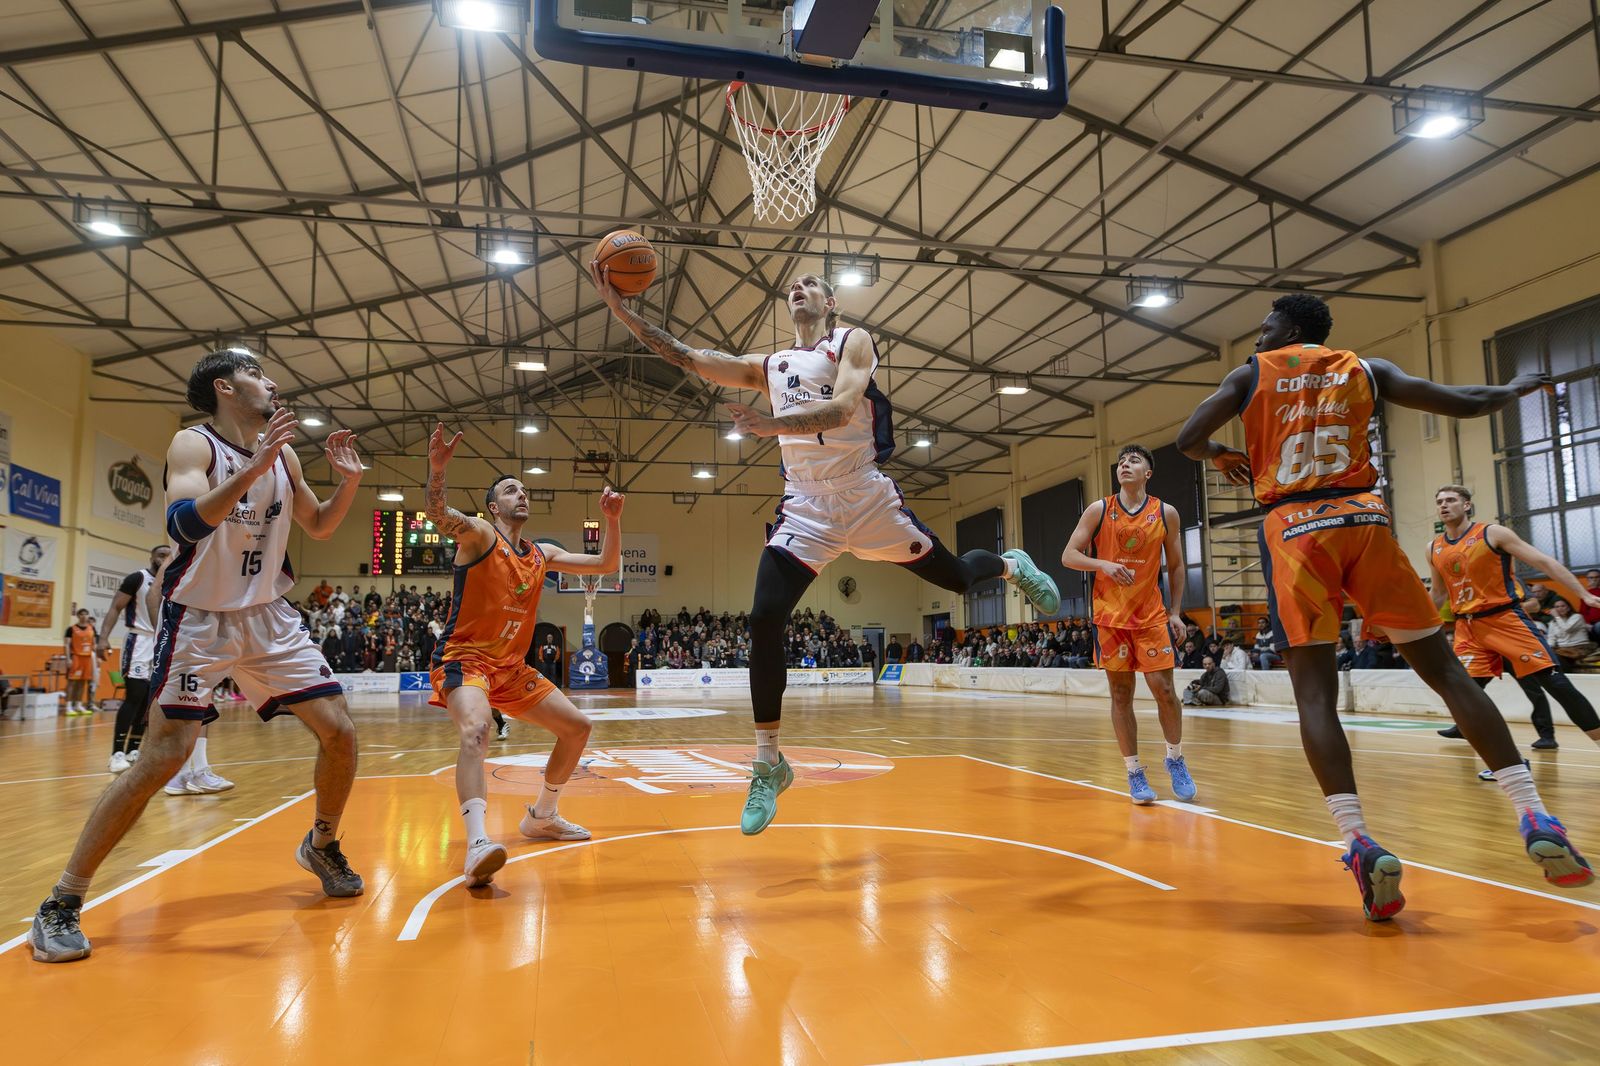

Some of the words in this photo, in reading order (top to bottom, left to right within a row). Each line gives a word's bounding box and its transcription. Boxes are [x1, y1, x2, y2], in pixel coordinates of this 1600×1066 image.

[781, 387, 811, 406] Jaén
[1276, 424, 1350, 486] 85
[12, 474, 33, 500] Cal
[35, 483, 60, 508] Viva
[112, 472, 152, 502] Fragata
[785, 534, 795, 547] 7
[241, 550, 262, 577] 15
[179, 673, 199, 693] 15
